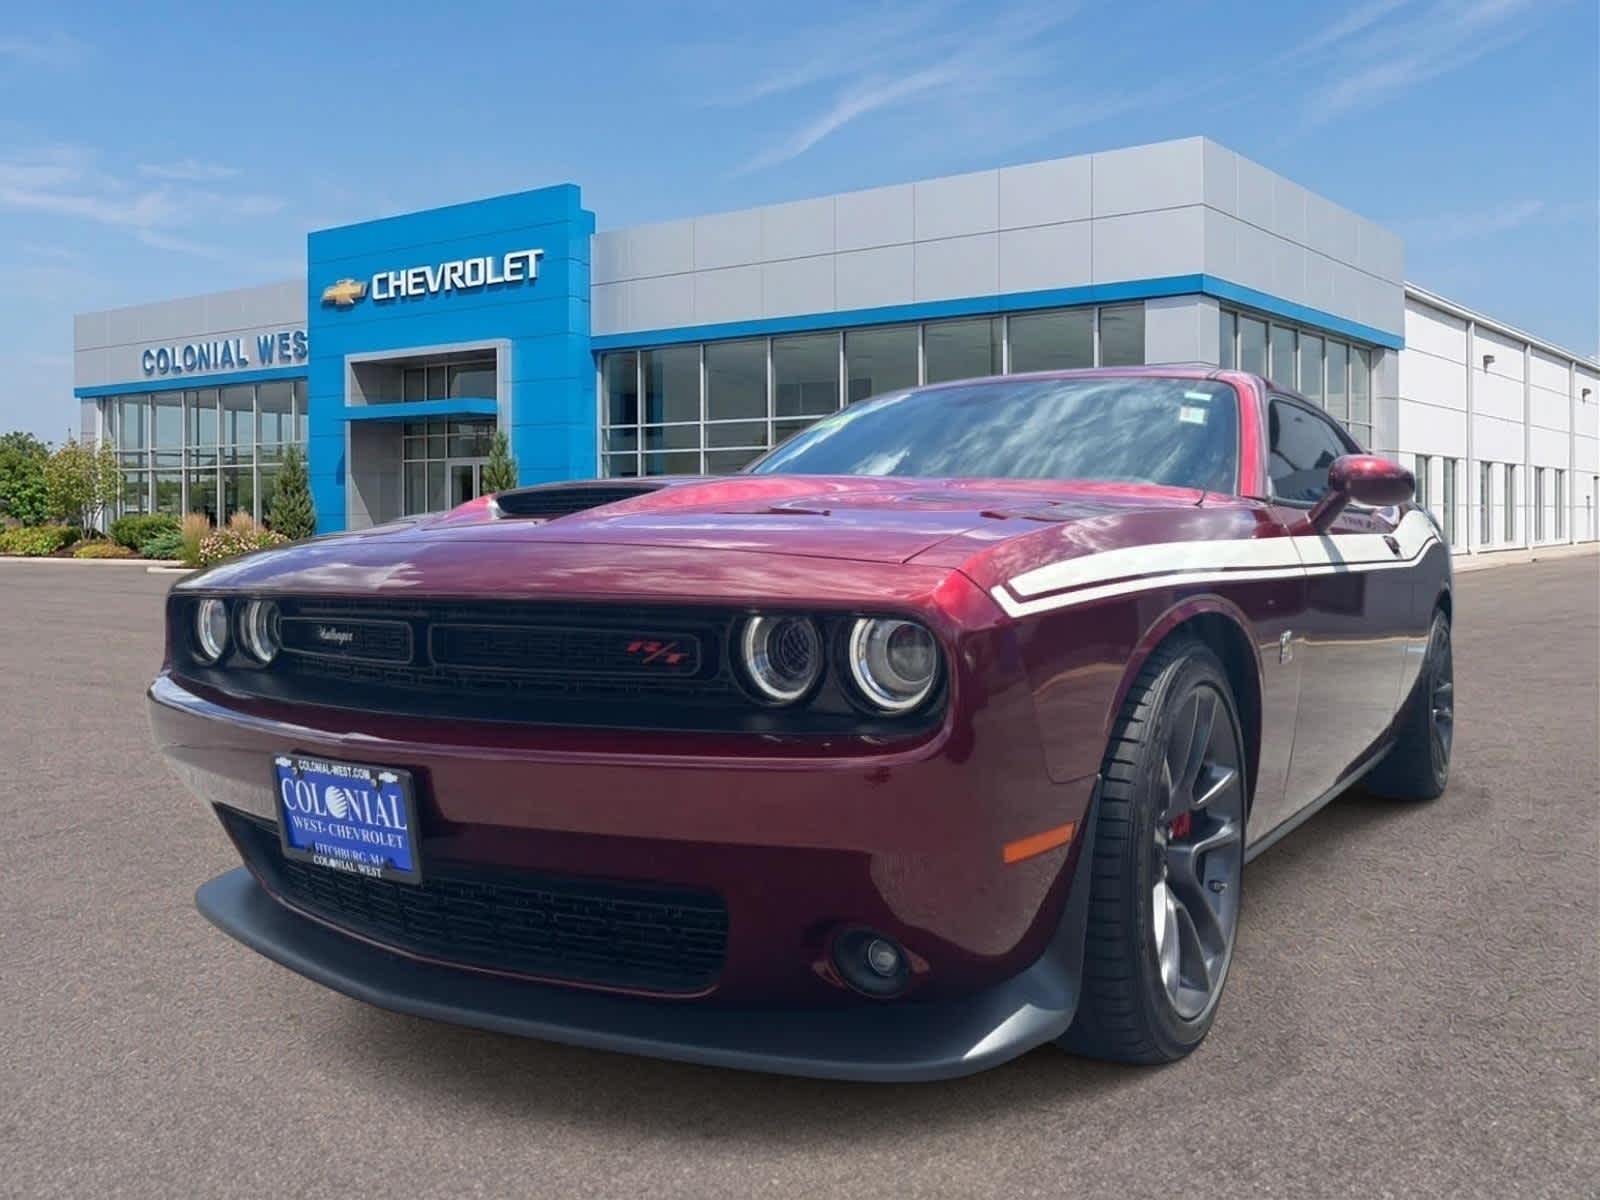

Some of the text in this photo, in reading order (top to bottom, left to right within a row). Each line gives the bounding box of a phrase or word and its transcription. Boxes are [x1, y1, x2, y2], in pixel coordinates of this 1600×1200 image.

[372, 249, 544, 300] CHEVROLET
[142, 339, 249, 376] COLONIAL
[328, 824, 404, 849] CHEVROLET
[357, 863, 382, 878] WEST
